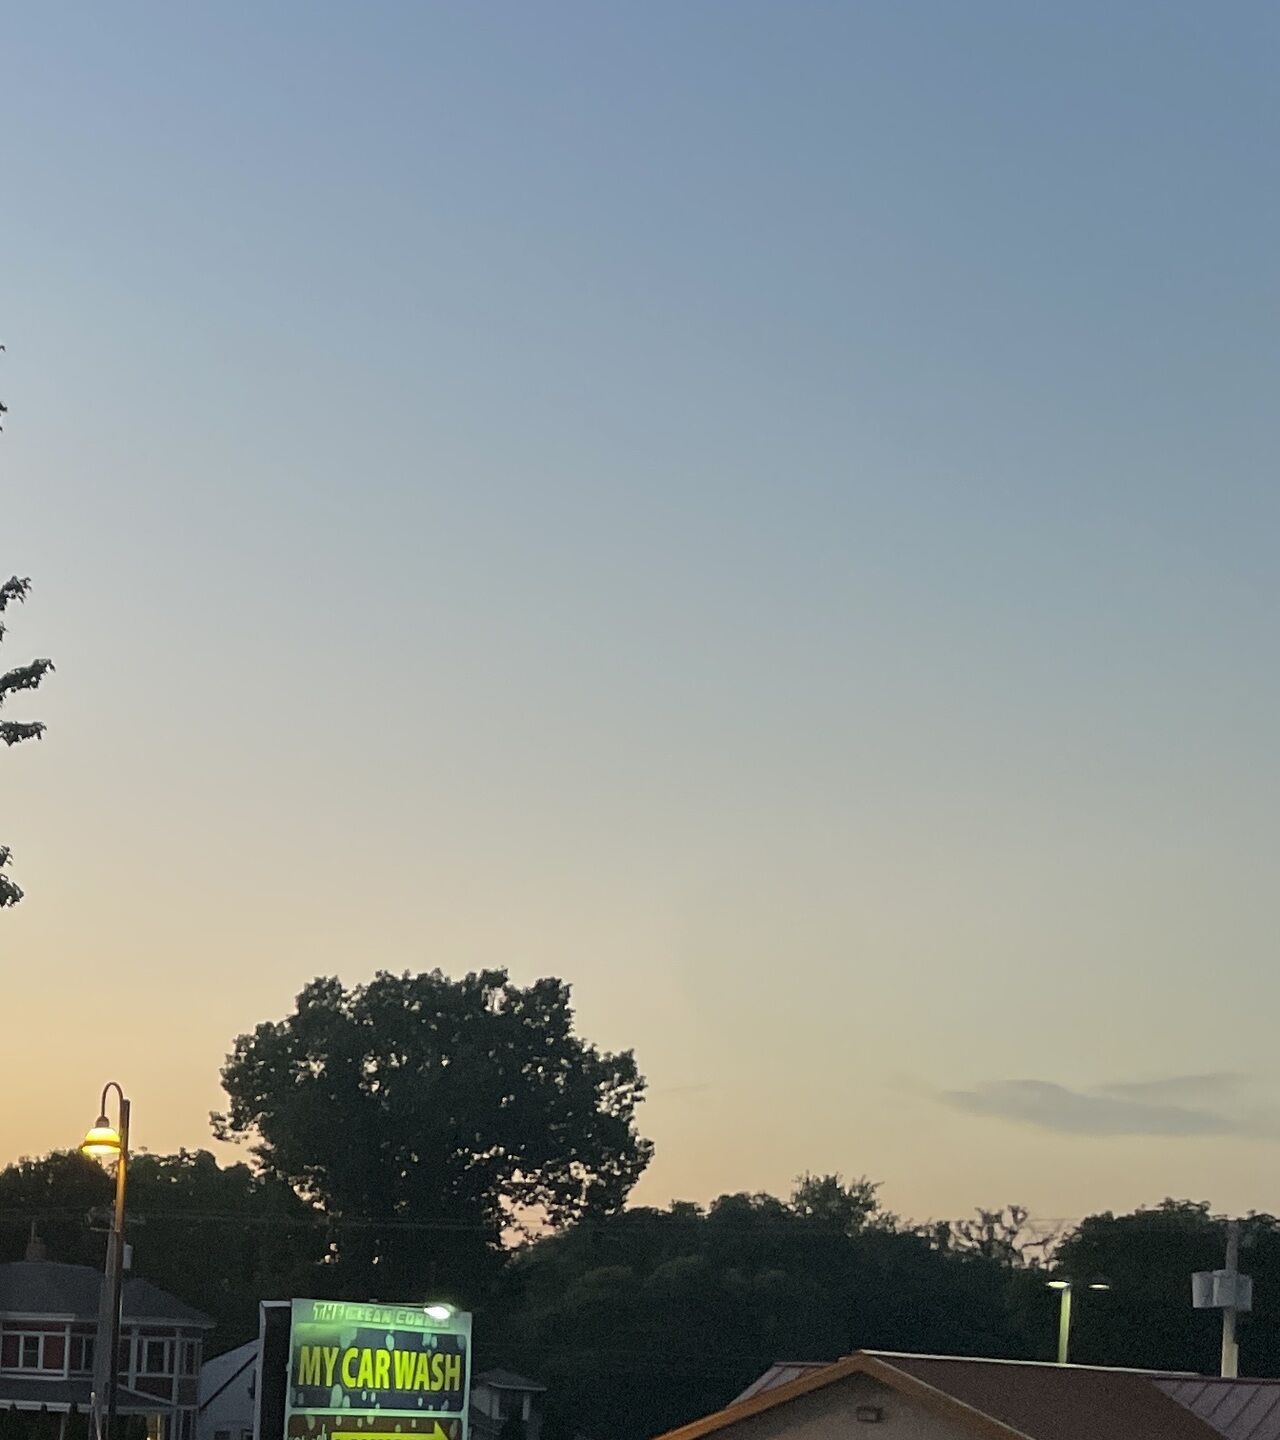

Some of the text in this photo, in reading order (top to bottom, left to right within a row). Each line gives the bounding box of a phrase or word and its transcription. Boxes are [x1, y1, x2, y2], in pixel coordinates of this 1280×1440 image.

[346, 1306, 391, 1323] CLEAN
[298, 1346, 461, 1391] MY CAR WASH
